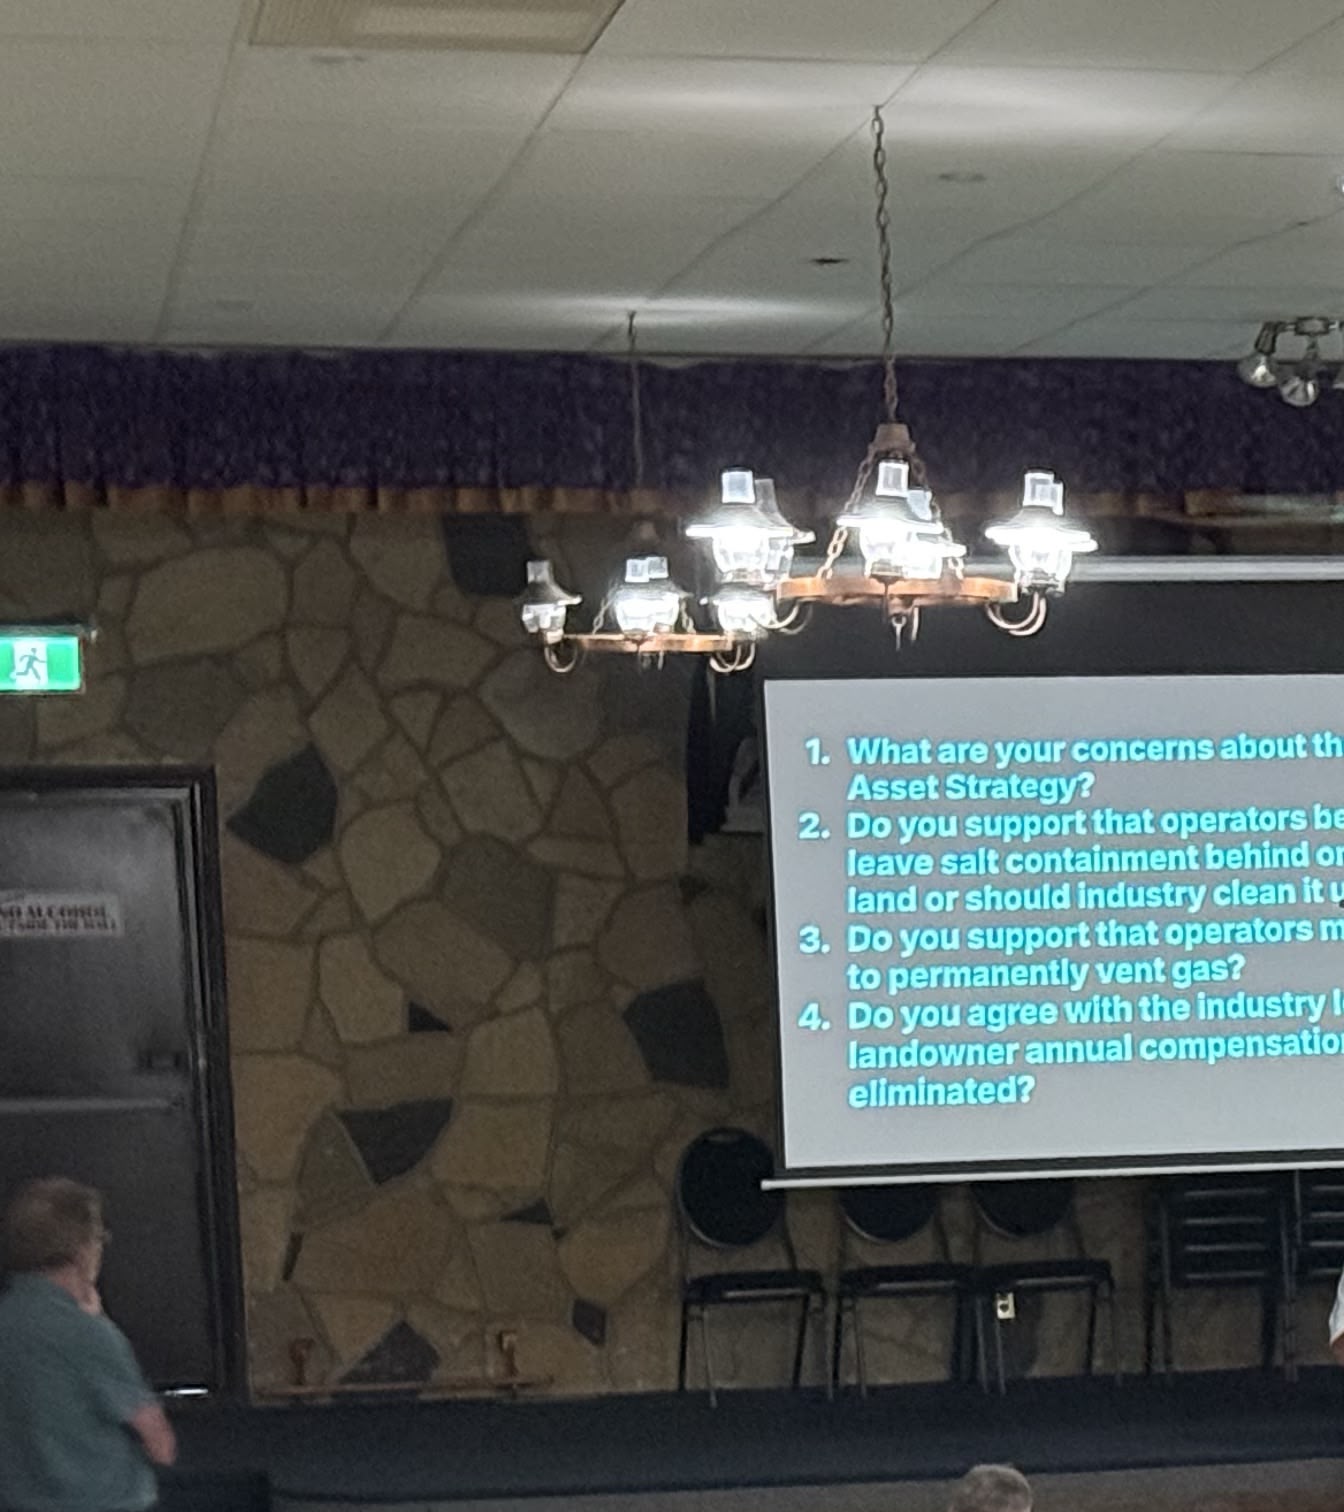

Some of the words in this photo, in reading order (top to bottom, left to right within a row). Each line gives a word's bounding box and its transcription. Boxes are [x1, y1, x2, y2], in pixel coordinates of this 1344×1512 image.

[805, 738, 830, 765] 1.
[846, 736, 933, 765] What
[936, 740, 990, 765] are
[993, 739, 1067, 769] your
[1069, 736, 1216, 764] concerns
[1217, 732, 1308, 761] about
[847, 772, 940, 801] Asset
[944, 770, 1094, 806] Strategy?
[798, 812, 830, 839] 2.
[846, 809, 893, 839] Do
[897, 813, 959, 844] you
[964, 808, 1089, 844] support
[1090, 807, 1156, 836] that
[1157, 805, 1309, 841] operators
[846, 848, 935, 877] leave
[938, 845, 1001, 876] salt
[1004, 843, 1201, 875] containment
[1203, 839, 1311, 871] behind
[844, 884, 918, 914] land
[922, 888, 960, 913] or
[964, 880, 1072, 913] should
[1075, 879, 1208, 914] industry
[1212, 878, 1298, 908] clean
[1300, 875, 1325, 903] it
[799, 925, 830, 953] 3.
[845, 922, 894, 953] Do
[898, 926, 961, 956] you
[963, 920, 1091, 957] support
[1092, 917, 1163, 948] that
[1162, 914, 1315, 952] operators
[844, 964, 882, 991] to
[884, 956, 1091, 995] permanently
[1093, 956, 1168, 985] vent
[1169, 950, 1246, 990] gas?
[798, 1003, 831, 1030] 4.
[847, 1000, 895, 1030] Do
[898, 1002, 962, 1032] you
[963, 999, 1060, 1034] agree
[1061, 992, 1134, 1025] with
[1135, 992, 1192, 1023] the
[1194, 990, 1328, 1024] industry
[846, 1038, 1021, 1070] landowner
[1022, 1032, 1134, 1065] annual
[847, 1072, 1035, 1109] eliminated?
